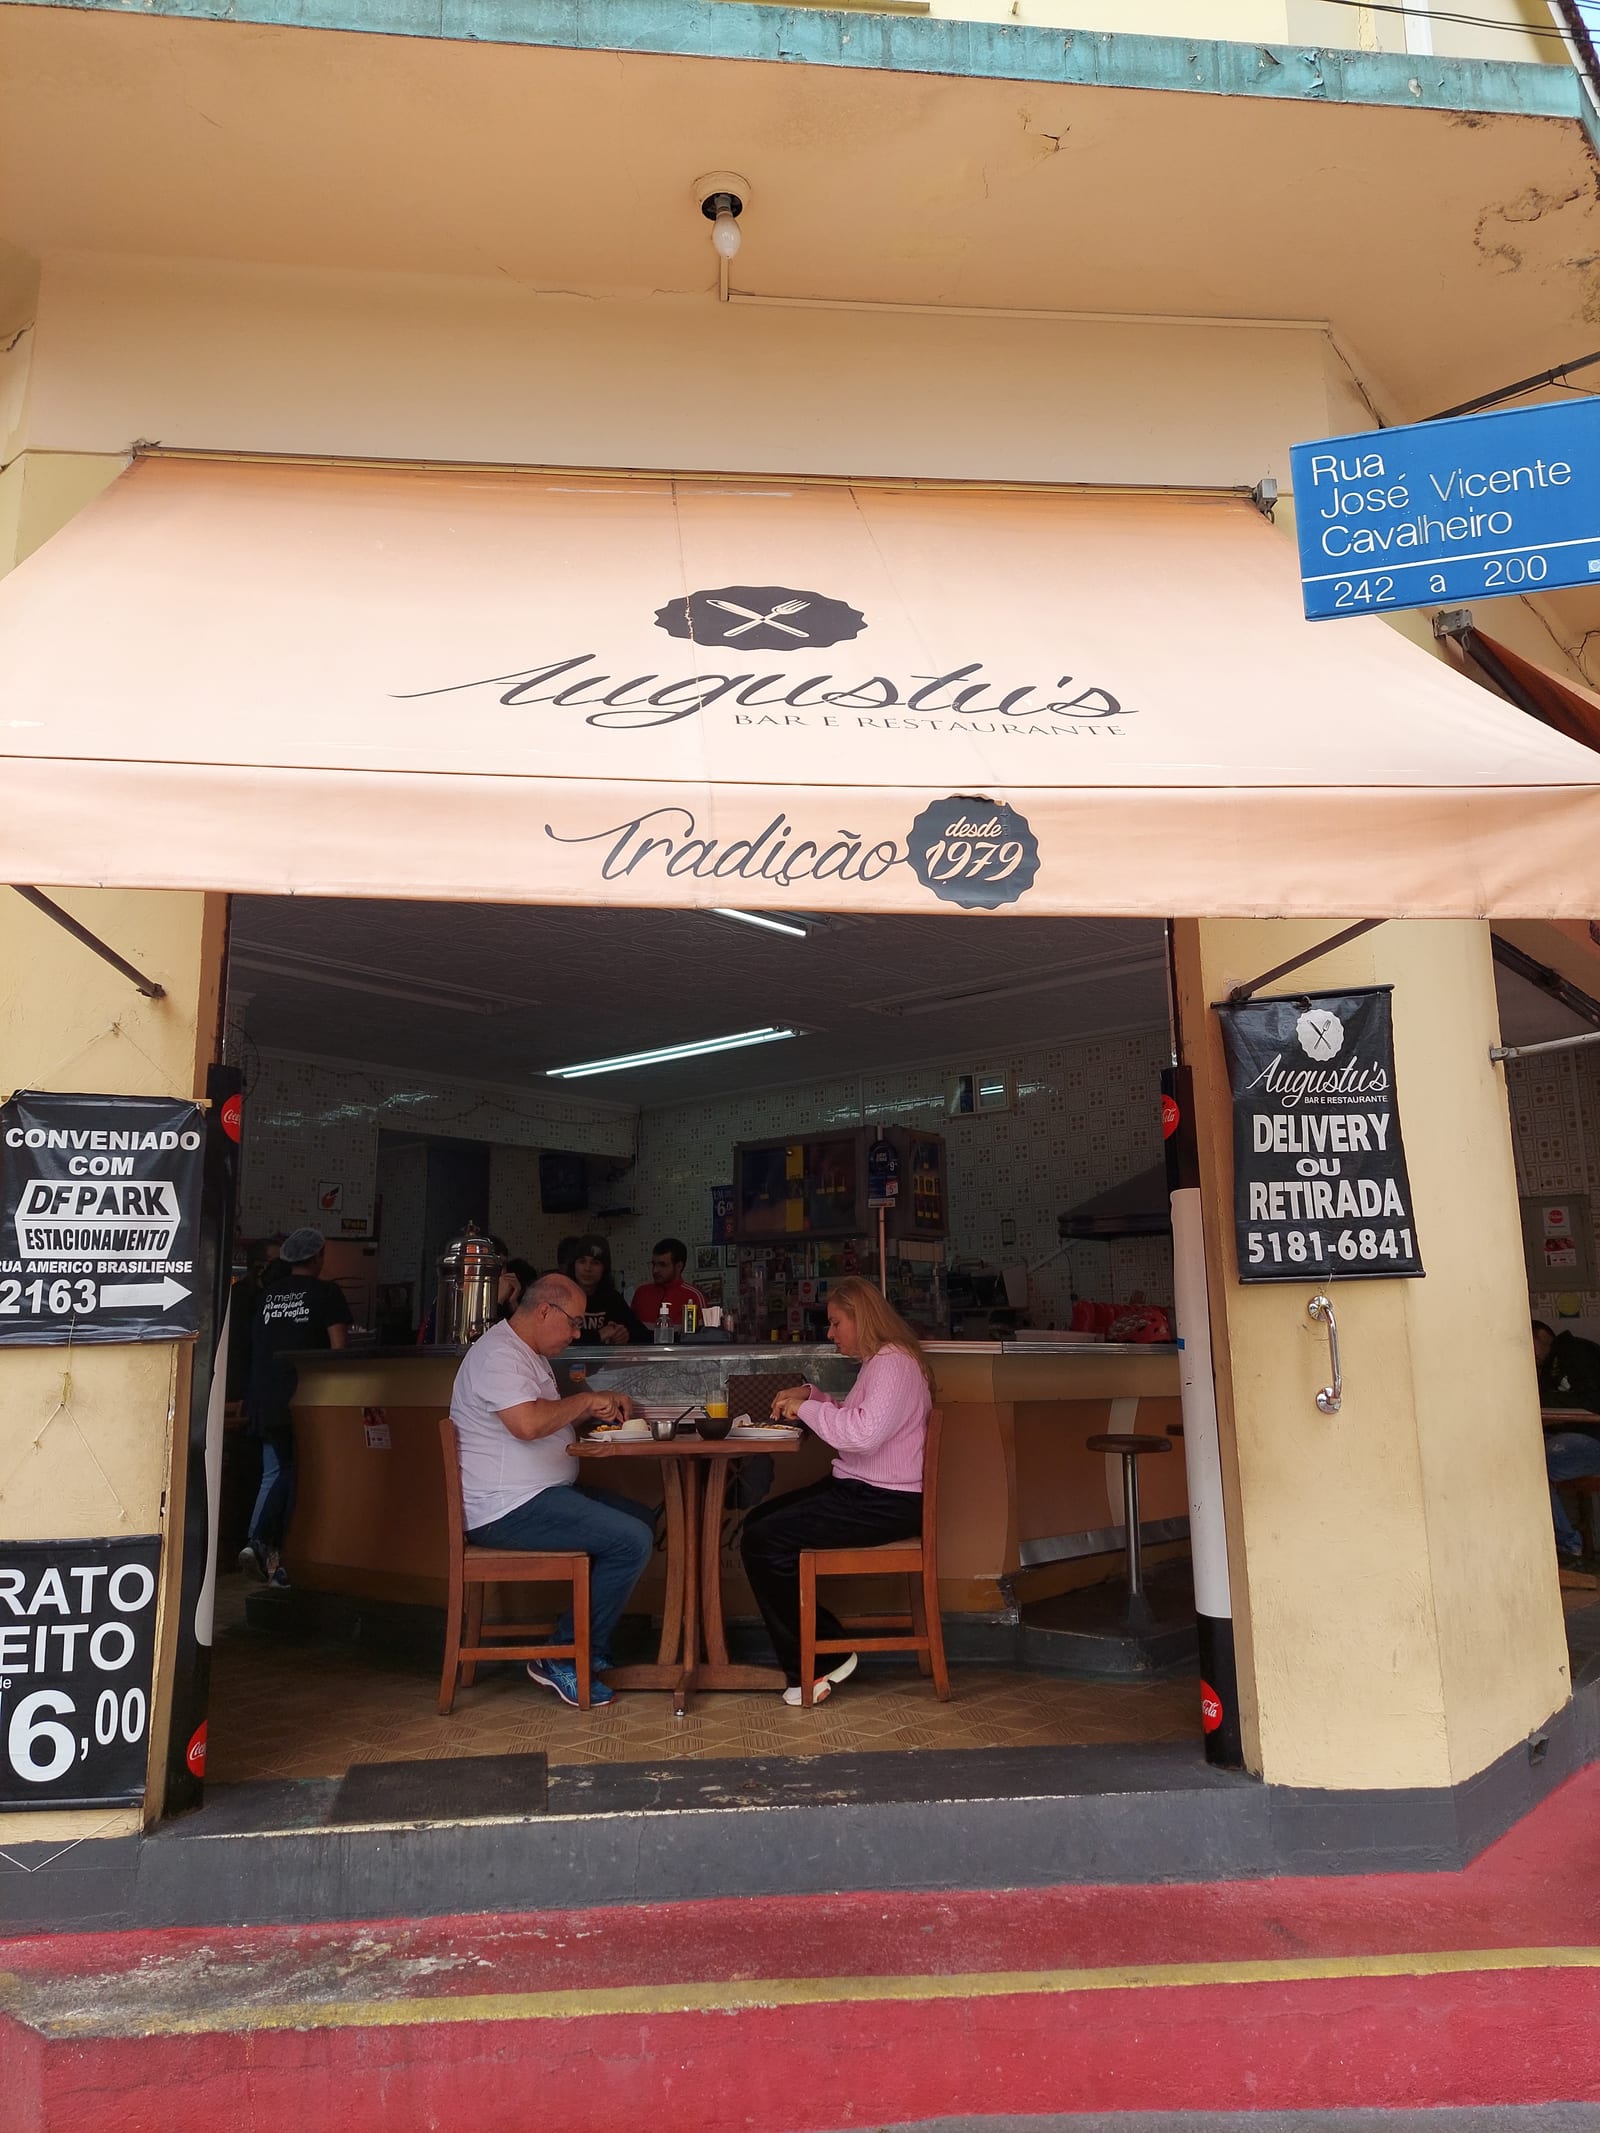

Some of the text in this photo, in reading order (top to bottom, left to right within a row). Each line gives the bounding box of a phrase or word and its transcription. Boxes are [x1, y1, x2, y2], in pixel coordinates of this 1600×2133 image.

[1311, 453, 1385, 486] Rua
[1320, 461, 1571, 519] José Vicente
[1321, 506, 1513, 557] Cavalheiro
[1334, 555, 1547, 608] 242 a 200
[388, 653, 1138, 729] Augustu's
[735, 714, 1127, 736] BAR E RESTAURANTE
[945, 816, 1003, 838] desde
[545, 807, 909, 887] Tradição
[925, 839, 1024, 881] 1979
[1246, 1054, 1389, 1108] Augustu's
[1304, 1095, 1388, 1104] BAR E RESTAURANTE
[5, 1128, 201, 1151] CONVENIADO
[1253, 1113, 1390, 1153] DELIVERY
[68, 1156, 135, 1176] COM
[1296, 1158, 1341, 1177] OU
[1250, 1178, 1405, 1220] RETIRADA
[25, 1228, 170, 1251] ESTACIONAMENTO
[1248, 1228, 1414, 1263] 5181-6841
[26, 1261, 93, 1273] AMERICO
[97, 1261, 192, 1273] BRASILIENSE
[0, 1279, 97, 1314] 2163
[271, 1306, 310, 1318] da região
[582, 1313, 606, 1330] ANS
[0, 1564, 155, 1615] RATO
[0, 1622, 135, 1673] EITO
[0, 1687, 146, 1782] 6,00
